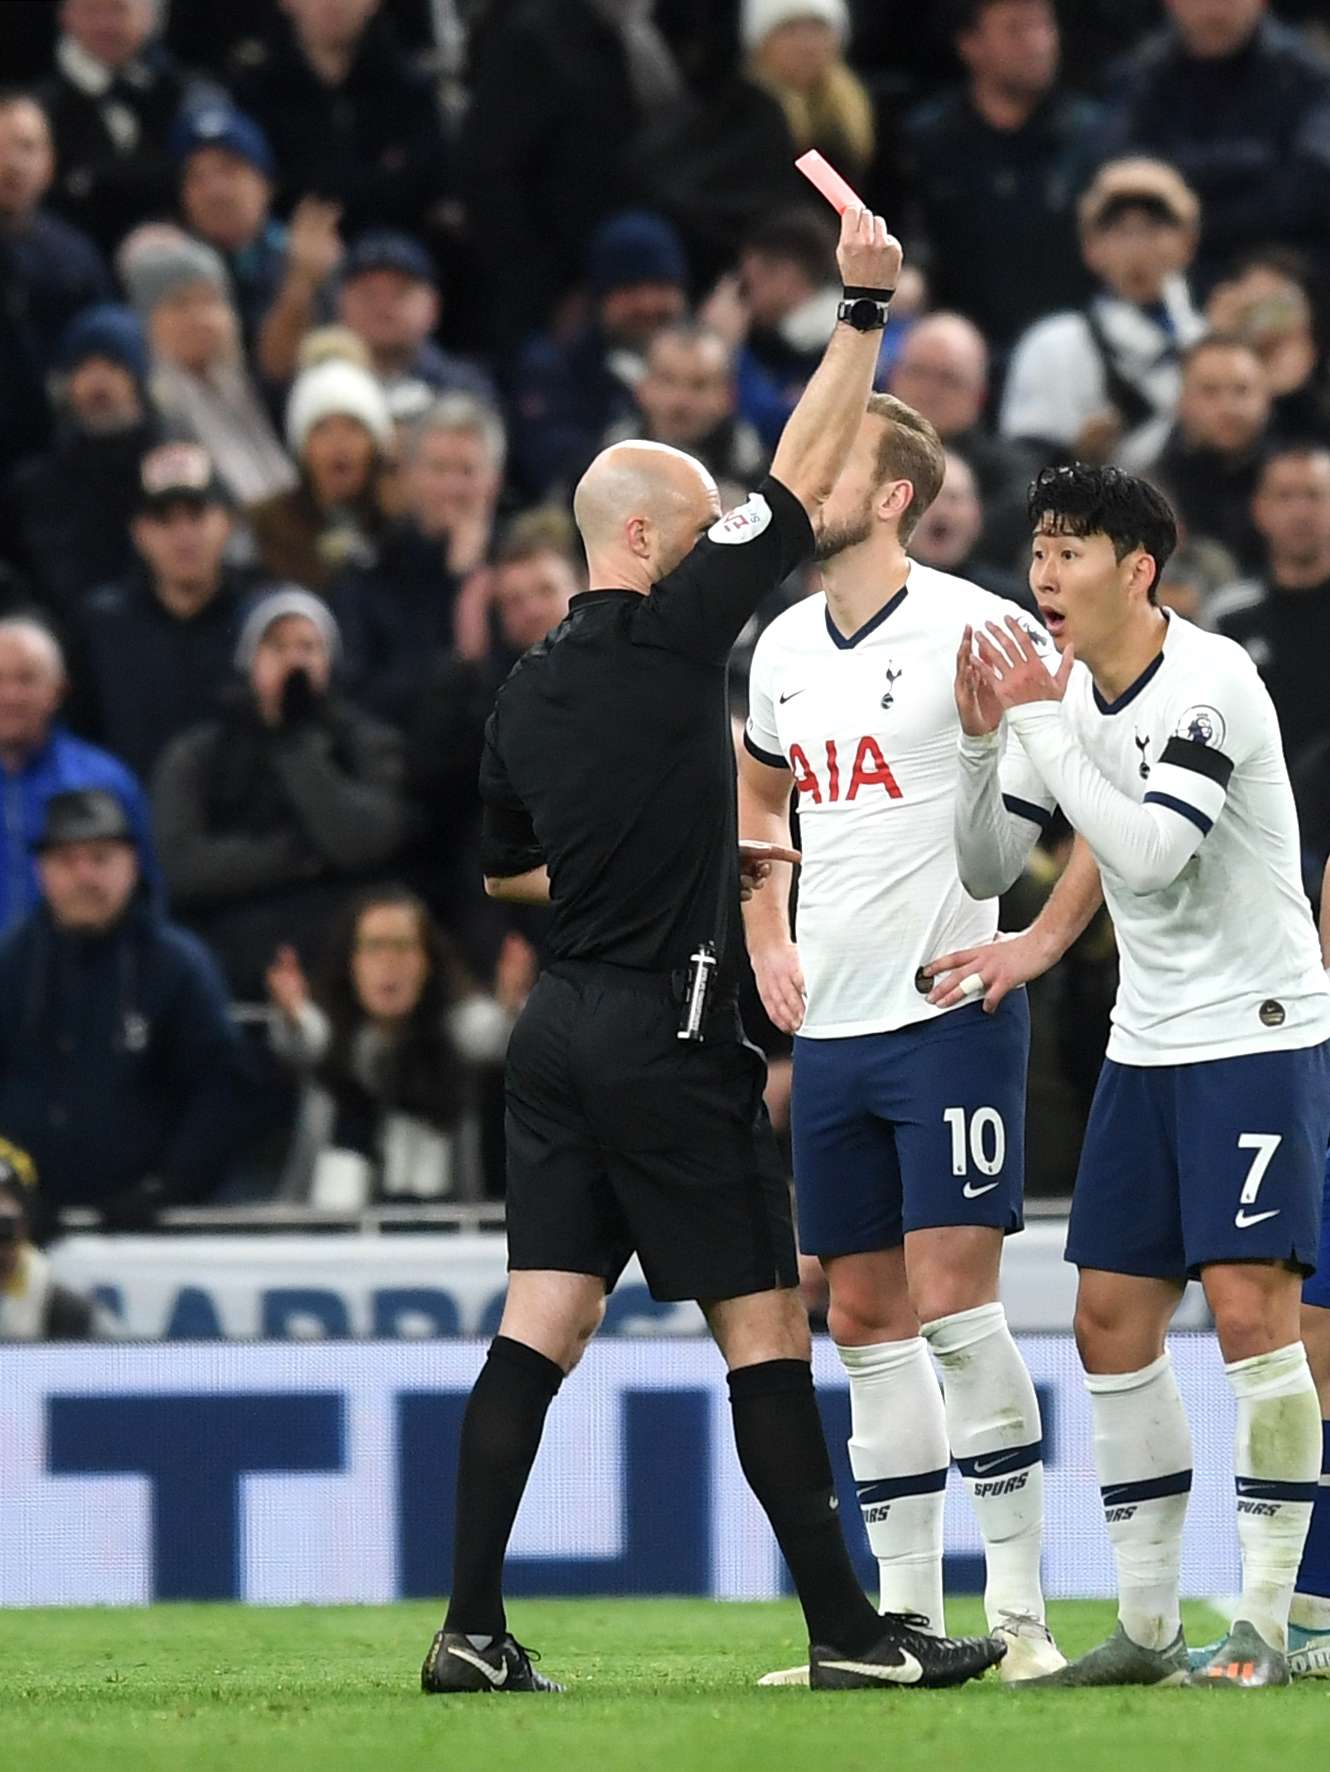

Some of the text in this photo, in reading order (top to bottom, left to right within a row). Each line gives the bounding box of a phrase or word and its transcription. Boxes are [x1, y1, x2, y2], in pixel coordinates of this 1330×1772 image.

[789, 735, 904, 805] AIA
[943, 1107, 1005, 1176] 10
[1238, 1133, 1282, 1204] 7
[974, 1471, 1029, 1498] SPURS
